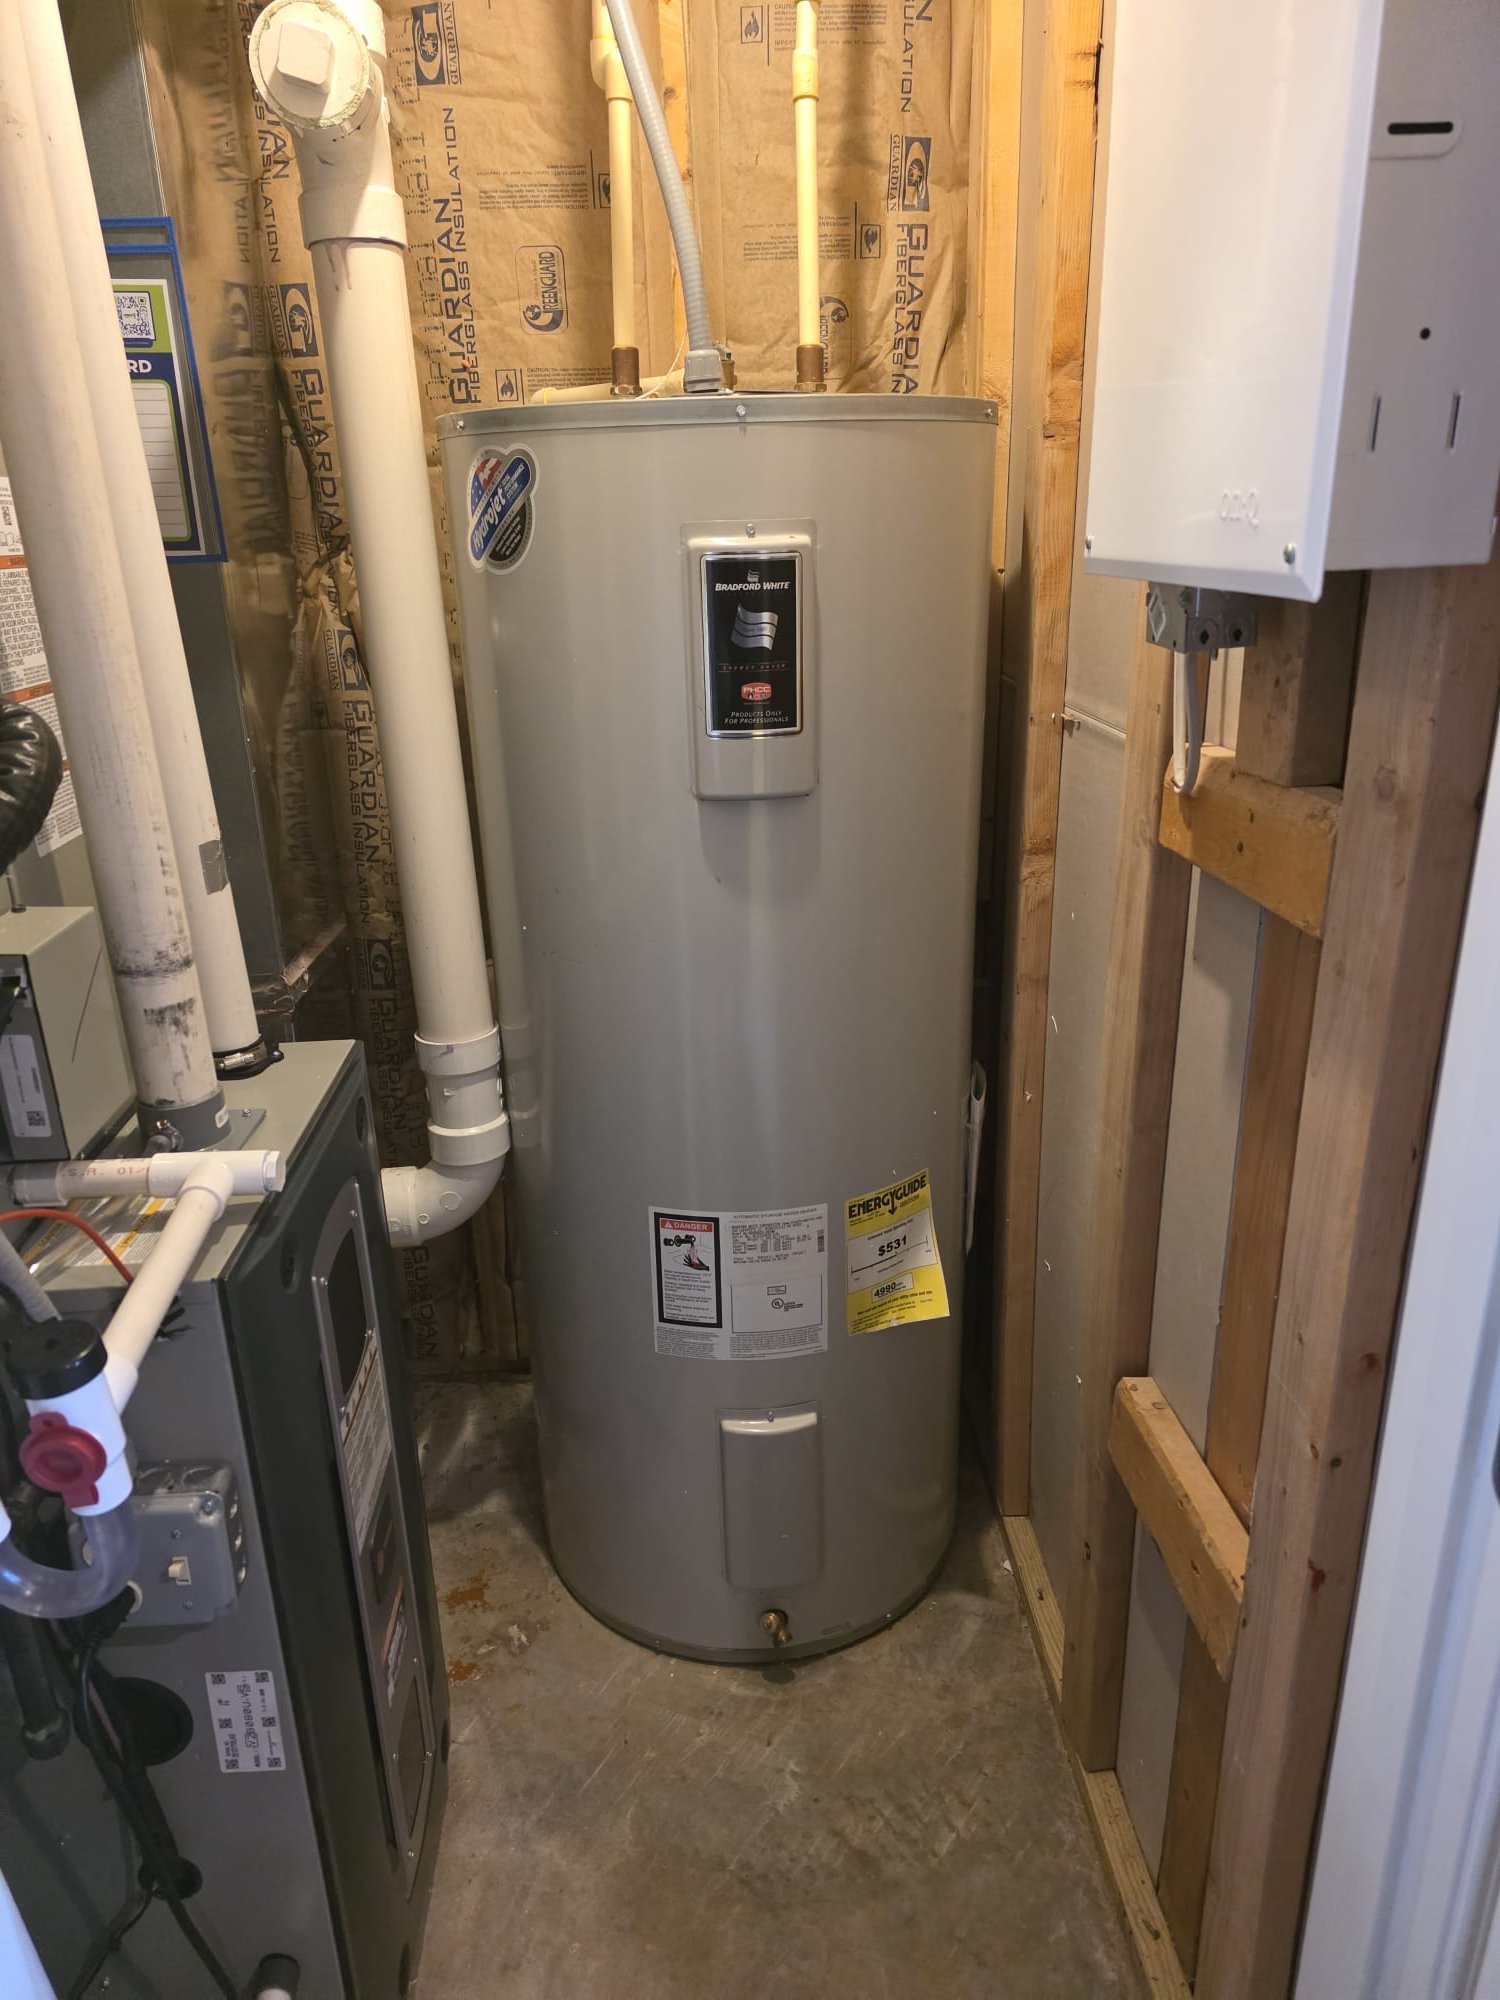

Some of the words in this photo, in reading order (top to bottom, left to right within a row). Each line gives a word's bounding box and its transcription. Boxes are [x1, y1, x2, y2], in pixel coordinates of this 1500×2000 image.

[443, 2, 459, 84] GUARDIAN
[901, 0, 915, 112] ULATION
[443, 108, 467, 252] INSULATION
[889, 134, 900, 211] GUARDIAN
[269, 286, 292, 359] GUARDIAN
[433, 199, 472, 404] GUARDIAN
[457, 261, 481, 403] FIBERGLASS
[892, 223, 909, 365] FIBERGLASS
[903, 223, 929, 394] GUARDIA
[301, 368, 350, 552] GUARDIAN
[472, 487, 506, 553] Hydrojet
[715, 583, 761, 591] BRADFORD
[763, 581, 790, 590] WHITE
[325, 629, 340, 690] GUARDIAN
[352, 701, 381, 864] GUARDIAN
[353, 822, 371, 924] INSULATION
[369, 999, 388, 1090] FIBERGLSS
[674, 1222, 708, 1231] DANGER
[849, 1175, 927, 1218] ENERGYGUIDE
[874, 1282, 896, 1298] 4990
[878, 1235, 907, 1257] $531
[413, 1246, 438, 1359] GUADIAN
